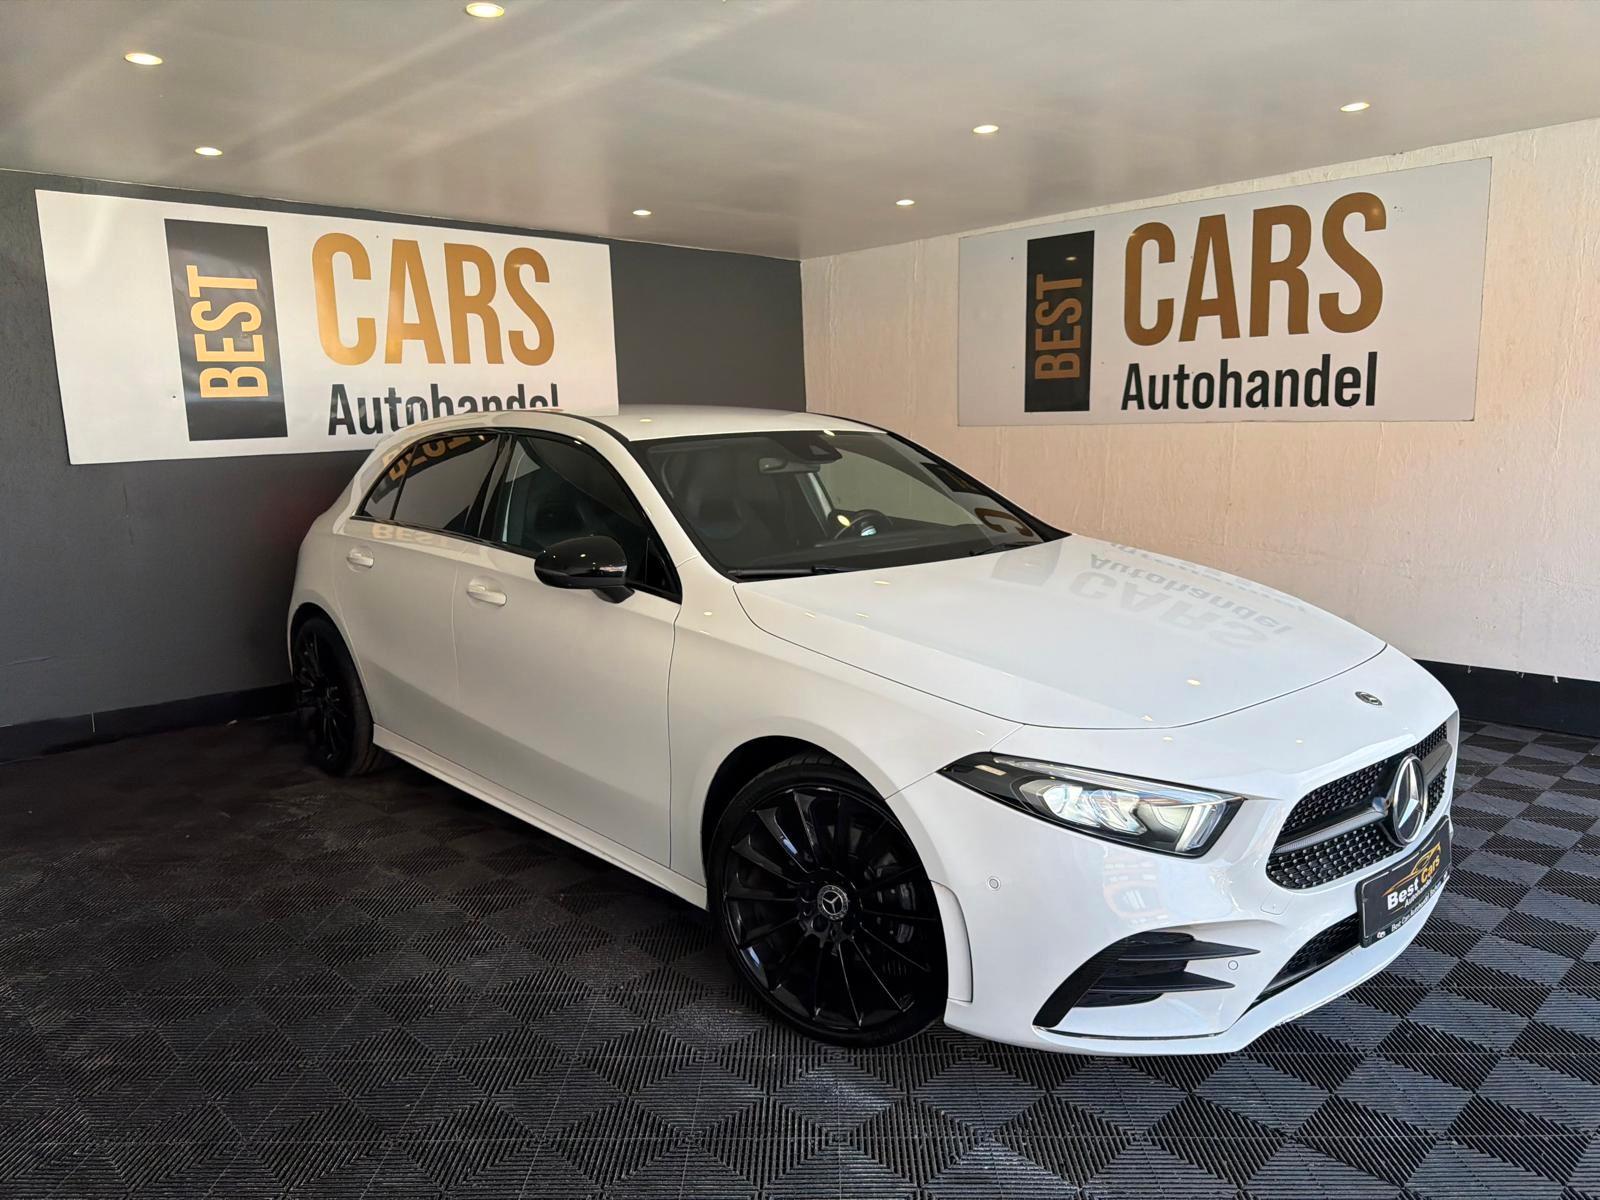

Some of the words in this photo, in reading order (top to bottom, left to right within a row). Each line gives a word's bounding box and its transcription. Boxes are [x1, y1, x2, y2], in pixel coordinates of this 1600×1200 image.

[312, 232, 555, 366] CARS
[1035, 273, 1084, 380] BEST
[1124, 191, 1387, 346] CARS
[187, 264, 269, 399] BEST
[1121, 351, 1378, 411] Autohandel
[1387, 877, 1418, 911] Best
[1421, 855, 1440, 883] Cars
